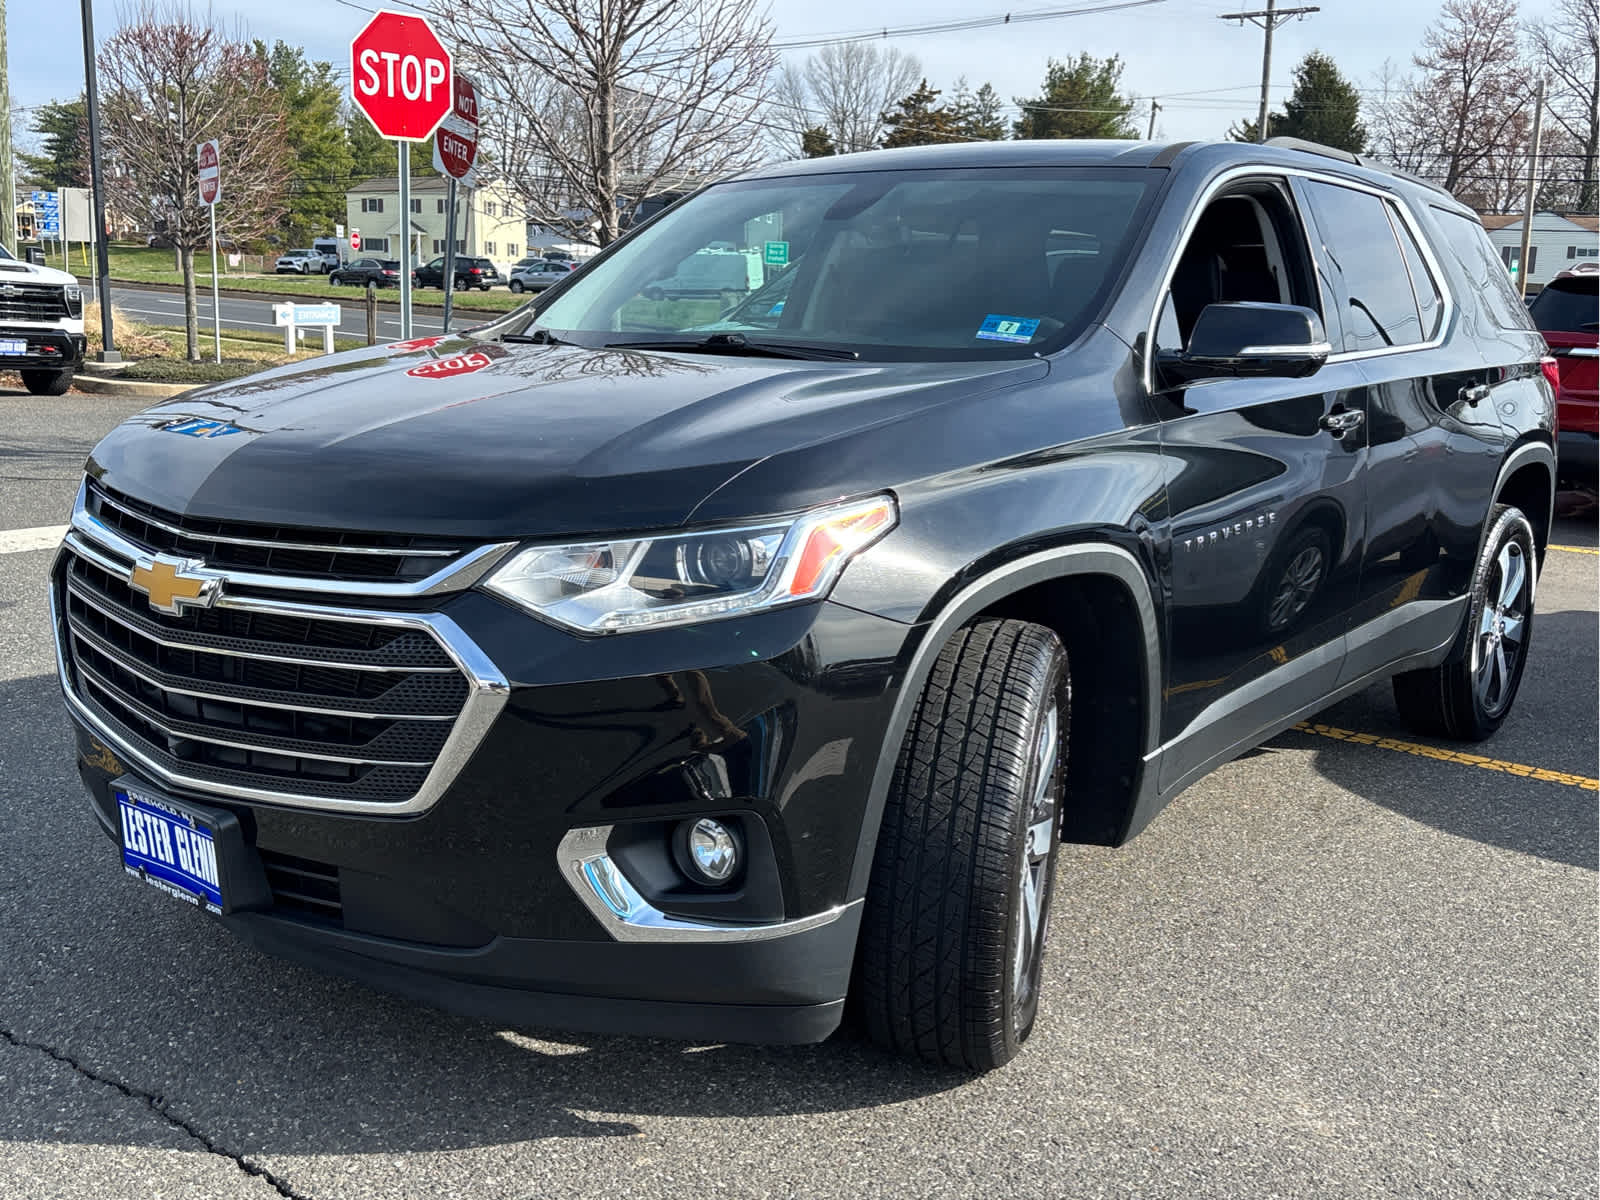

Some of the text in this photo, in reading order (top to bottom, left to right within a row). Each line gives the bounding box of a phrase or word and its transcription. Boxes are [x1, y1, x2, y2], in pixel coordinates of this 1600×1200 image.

[359, 49, 446, 102] STOP
[457, 95, 474, 117] NOT
[443, 136, 468, 161] ENTER
[1004, 322, 1015, 332] 7
[1184, 513, 1277, 552] TRAVERSE
[120, 804, 220, 888] LESTER GLENN
